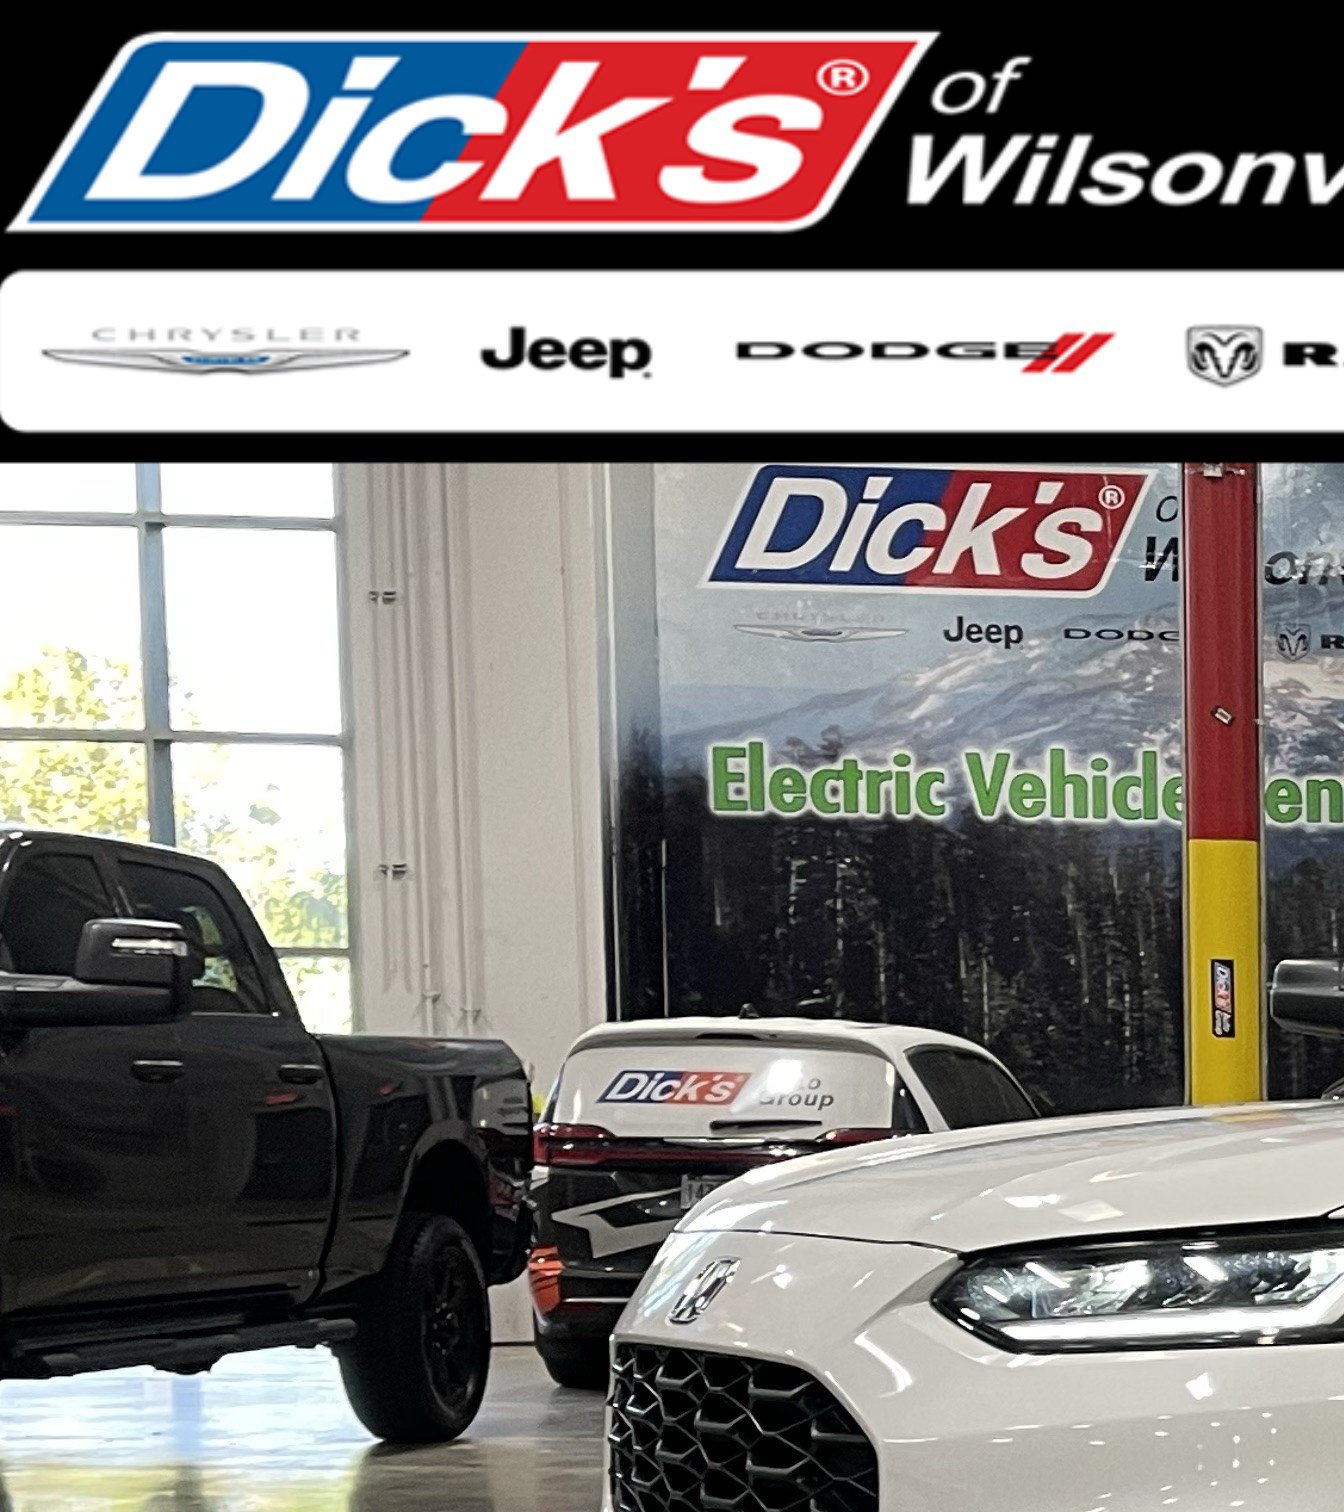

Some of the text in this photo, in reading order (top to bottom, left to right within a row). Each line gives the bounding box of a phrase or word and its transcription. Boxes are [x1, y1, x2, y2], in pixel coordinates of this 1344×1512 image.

[943, 616, 1024, 649] Jeep
[711, 741, 945, 817] Electric
[965, 747, 1182, 821] Vehicle
